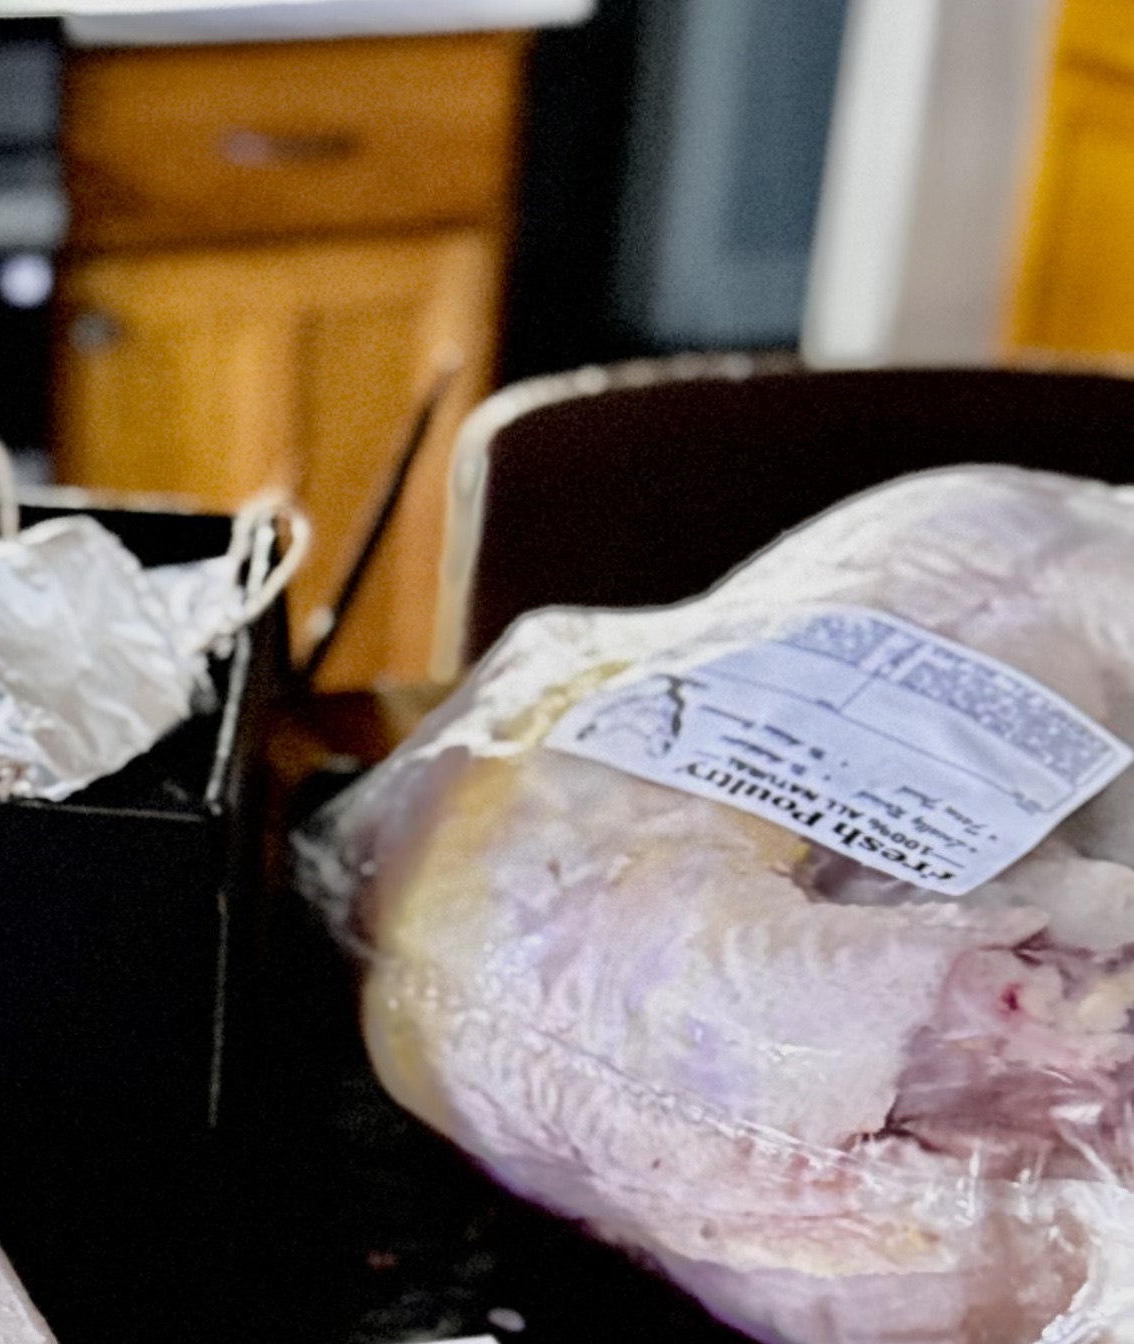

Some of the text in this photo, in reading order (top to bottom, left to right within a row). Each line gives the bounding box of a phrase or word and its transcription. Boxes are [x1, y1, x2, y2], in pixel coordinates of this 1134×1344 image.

[678, 760, 824, 827] Poultry
[823, 797, 865, 820] ALL
[868, 817, 934, 856] 100%
